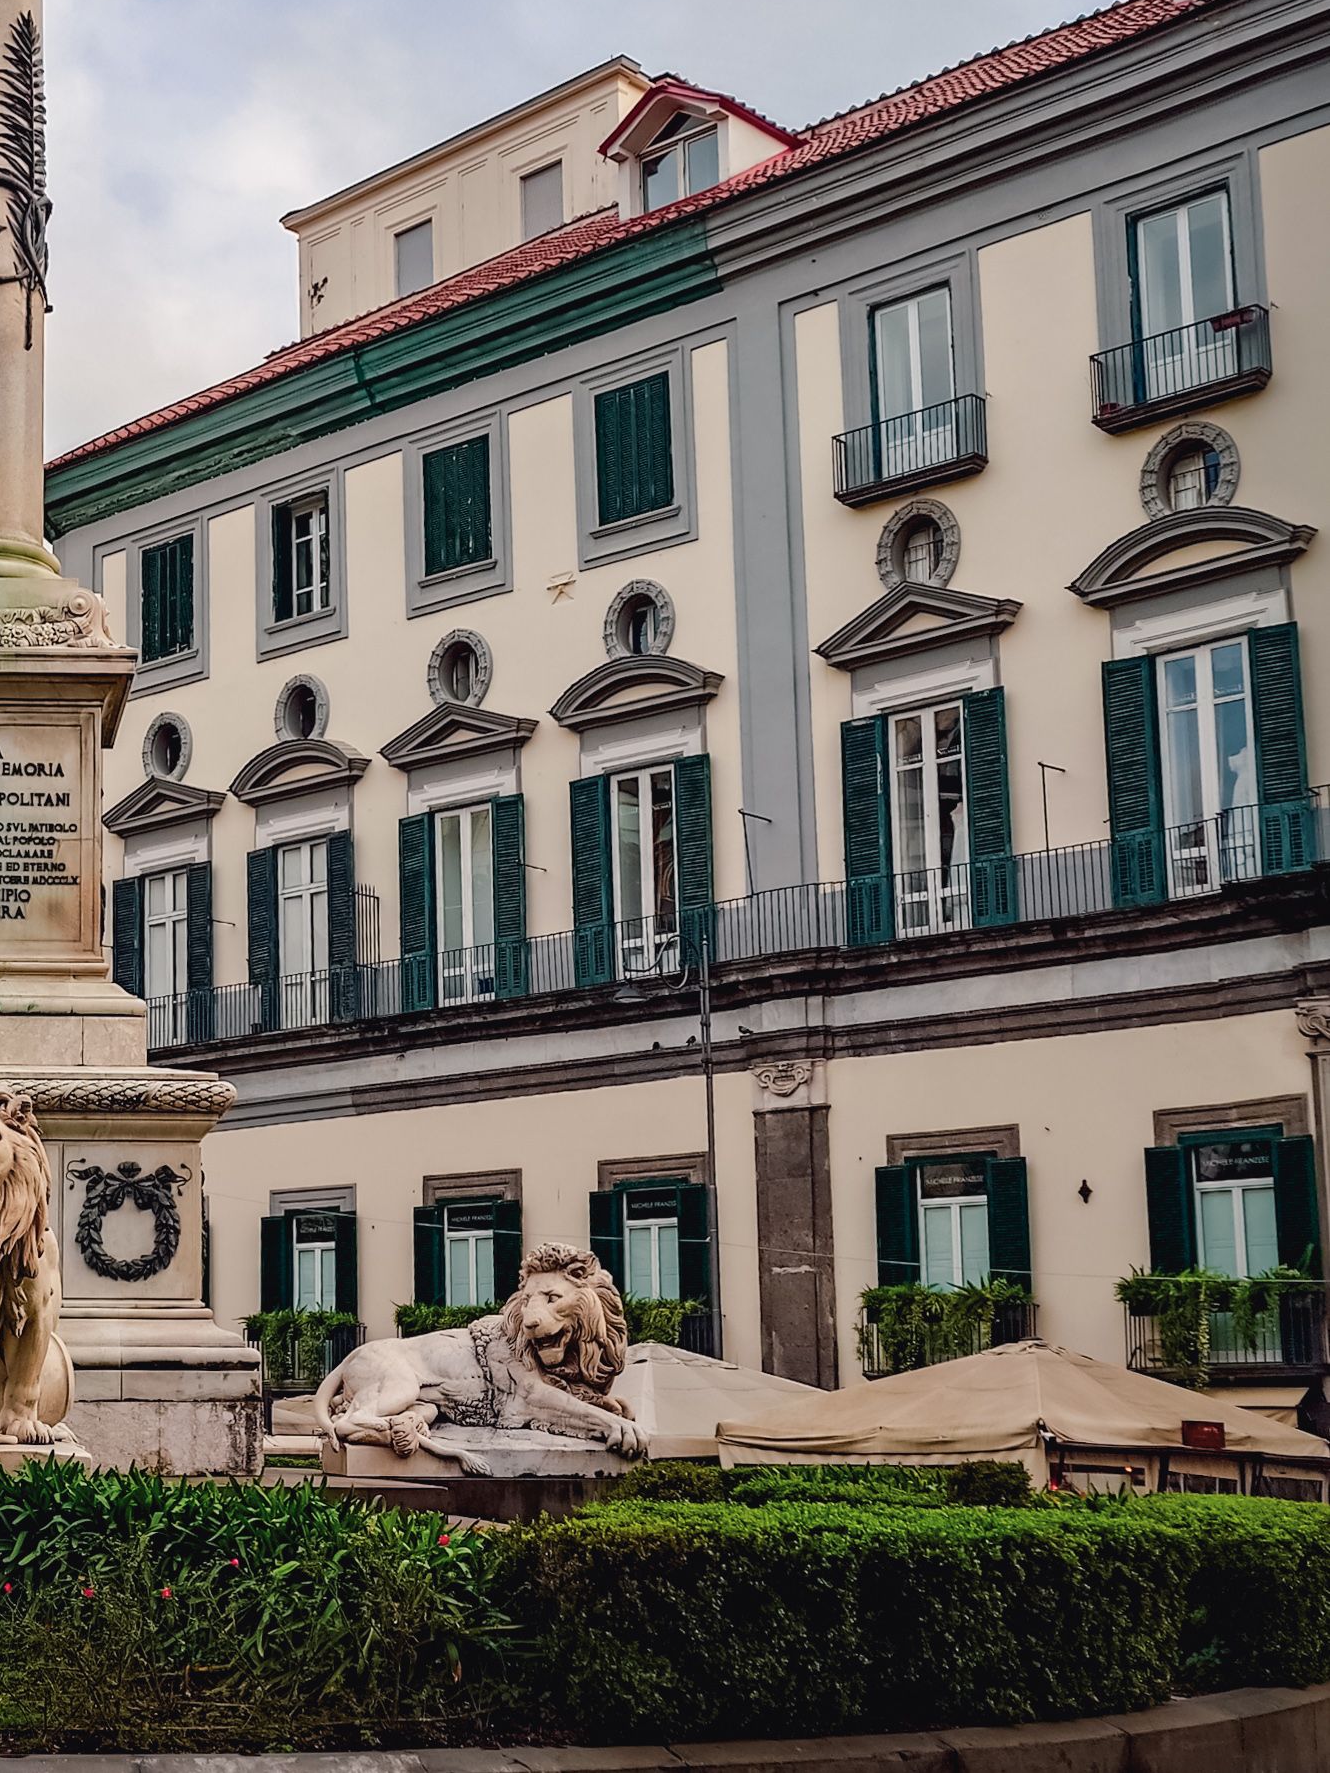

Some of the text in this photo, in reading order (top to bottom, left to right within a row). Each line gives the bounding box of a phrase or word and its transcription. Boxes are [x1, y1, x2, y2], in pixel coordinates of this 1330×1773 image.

[6, 822, 26, 832] SVL
[28, 823, 78, 833] PATIBOLO
[12, 836, 56, 846] POPOLO
[6, 862, 20, 872] ED
[22, 862, 66, 872] ETERNO
